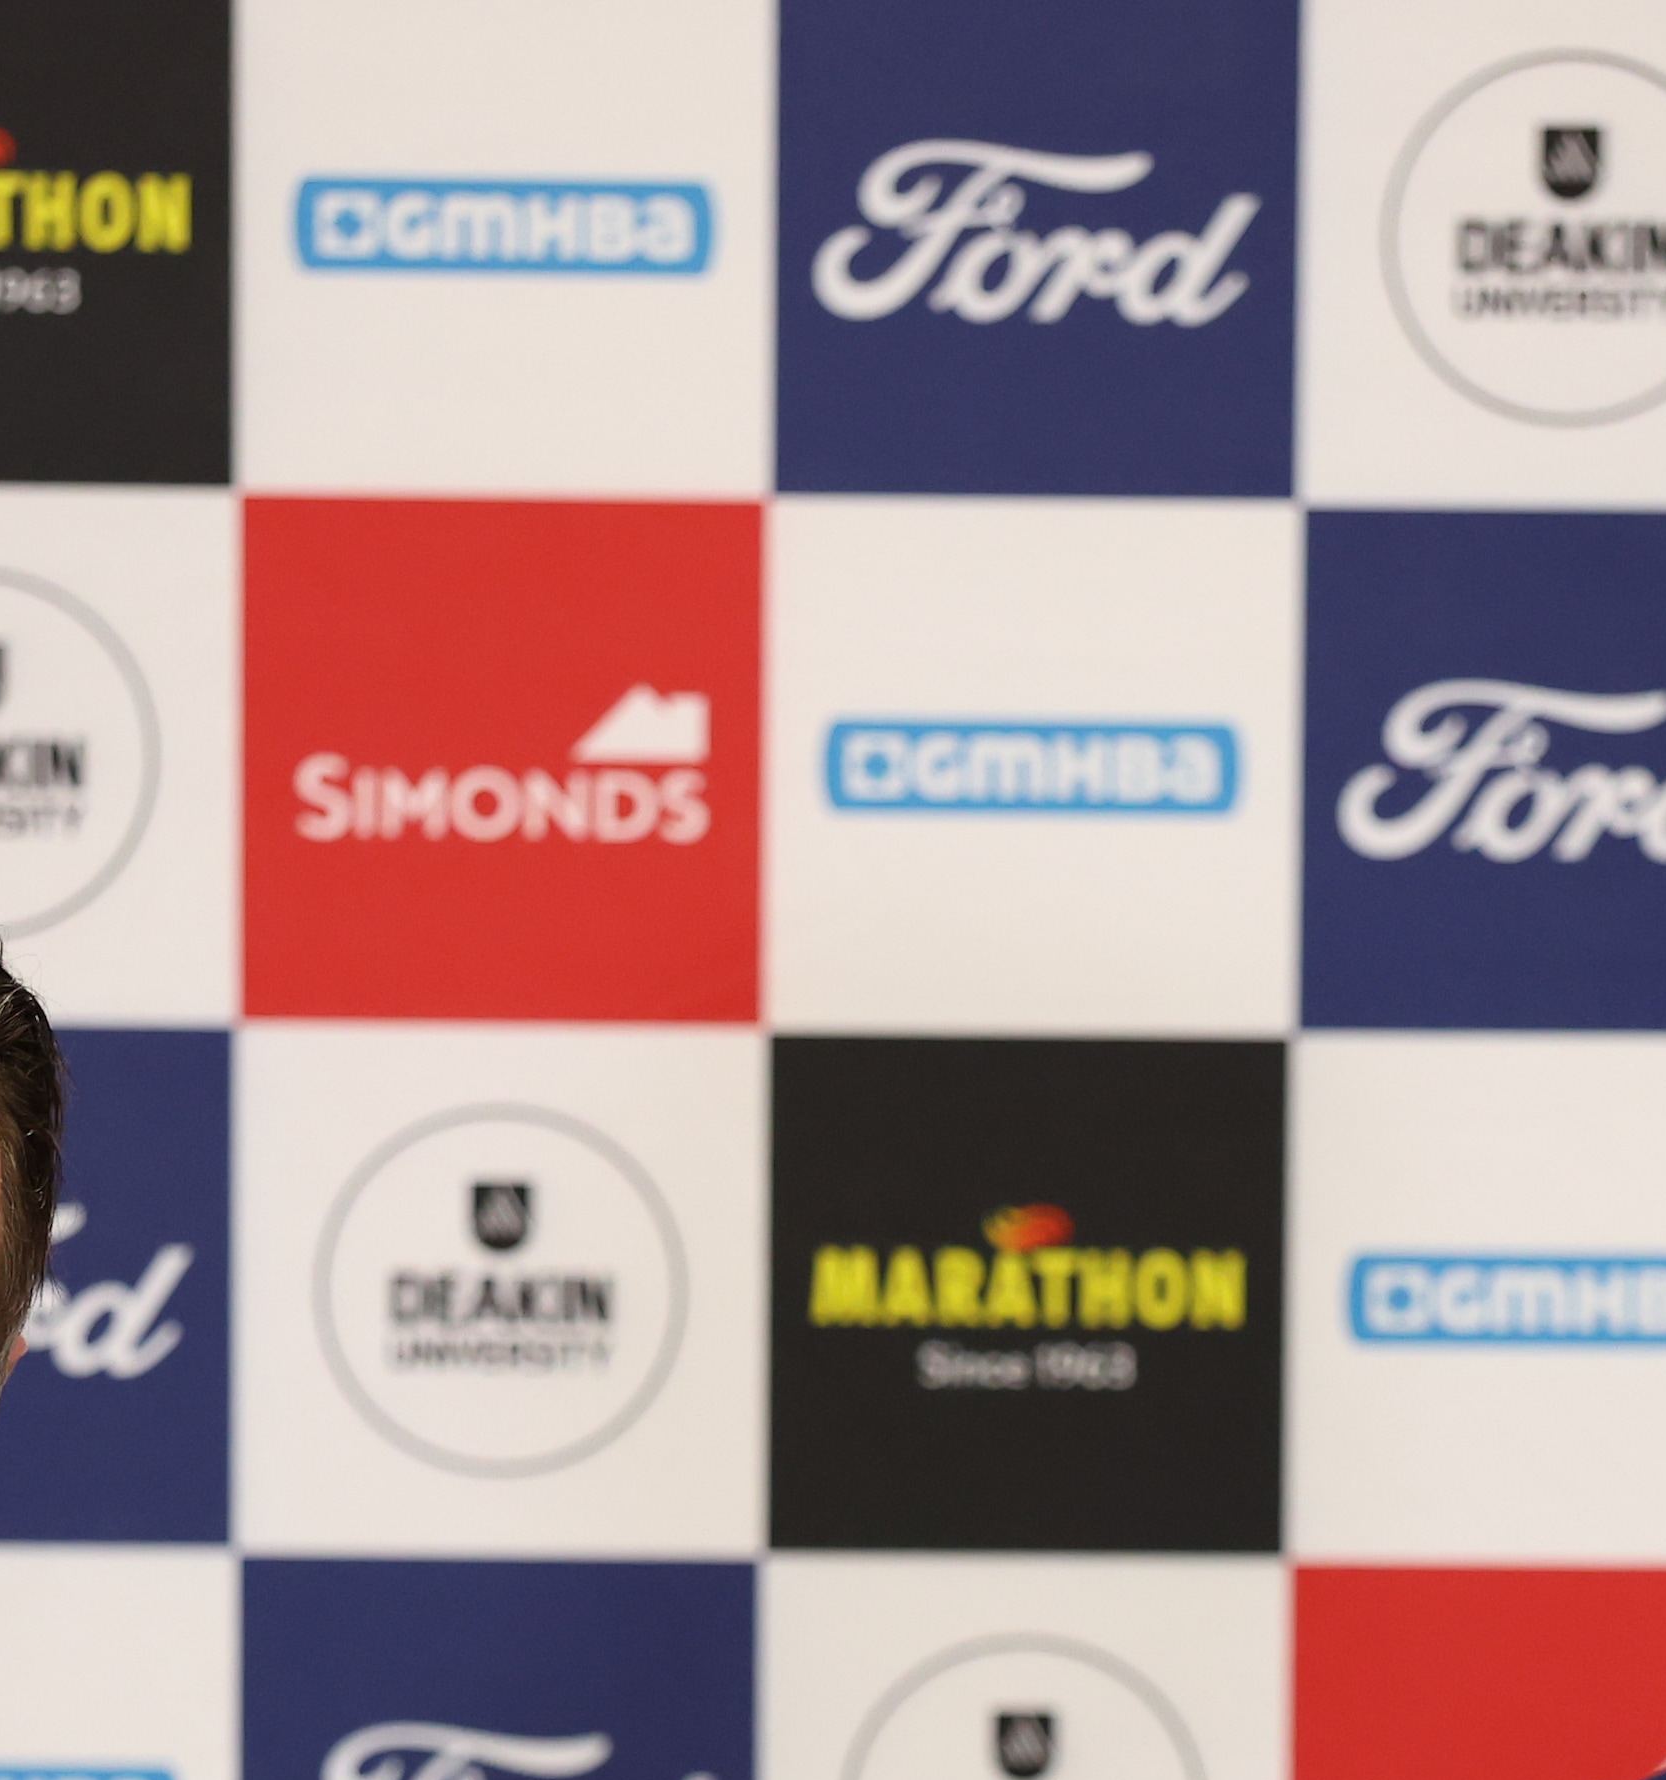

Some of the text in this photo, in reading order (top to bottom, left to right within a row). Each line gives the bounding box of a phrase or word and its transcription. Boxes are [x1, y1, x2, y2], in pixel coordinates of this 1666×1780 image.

[812, 139, 1259, 326] Ford
[295, 754, 710, 844] SIMONDS
[389, 1272, 614, 1327] DEAKIN
[811, 1248, 1246, 1329] MARATHON
[389, 1340, 612, 1372] UNIVERSITY
[917, 1341, 1136, 1389] Since 1963
